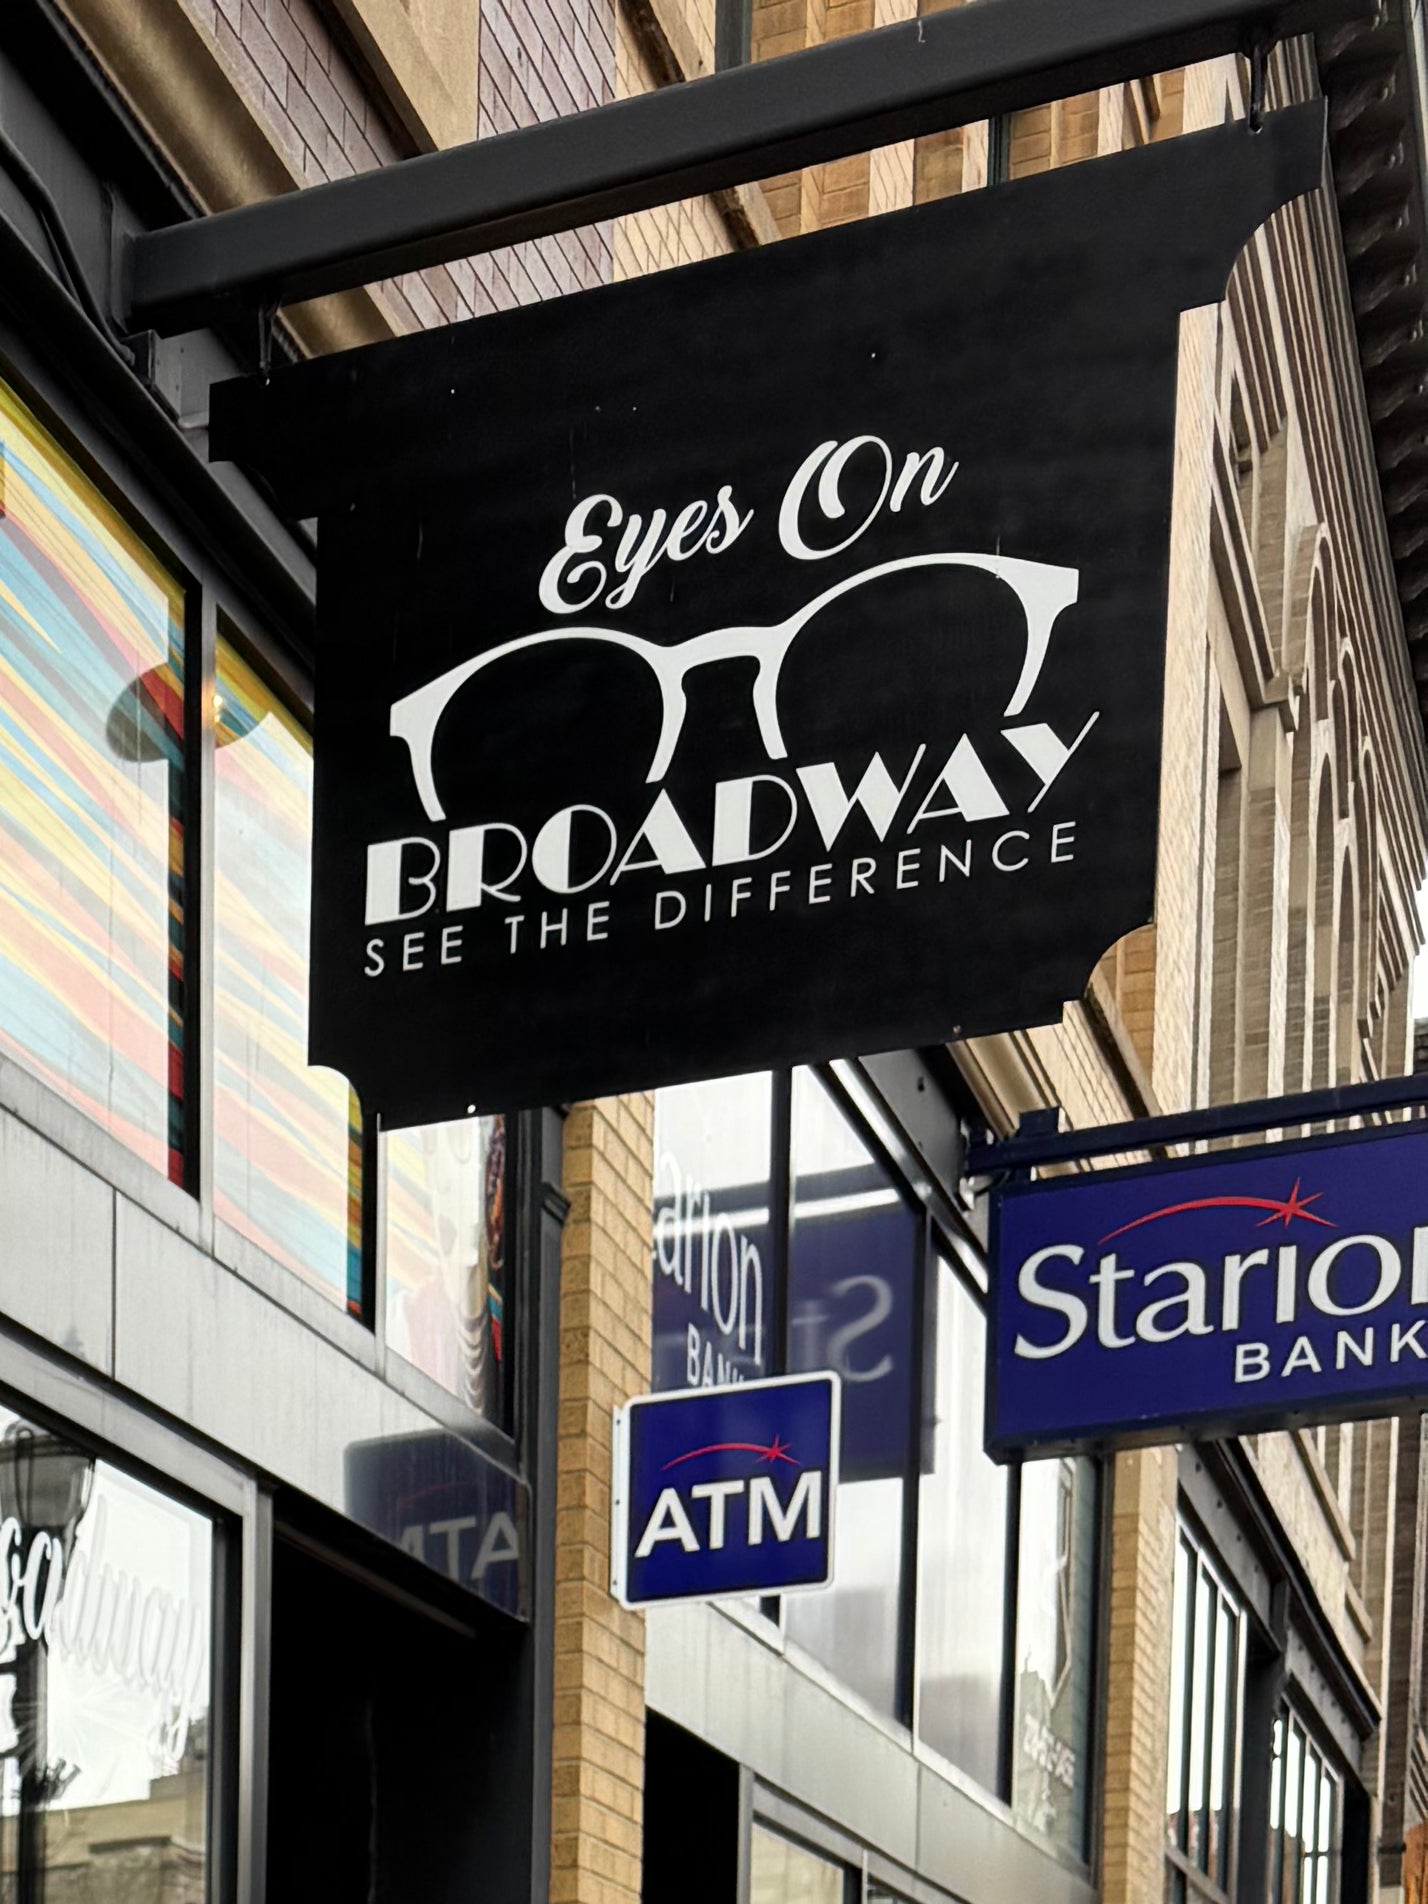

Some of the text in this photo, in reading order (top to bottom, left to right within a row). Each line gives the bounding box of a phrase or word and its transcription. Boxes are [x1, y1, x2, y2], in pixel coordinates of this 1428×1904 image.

[539, 435, 959, 614] Eyes On
[364, 710, 1100, 925] BROADWAY
[364, 821, 1076, 977] SEE THE DIFFERENCE
[1013, 1226, 1428, 1361] Stario
[1235, 1320, 1428, 1383] BANK
[634, 1470, 822, 1559] ATM
